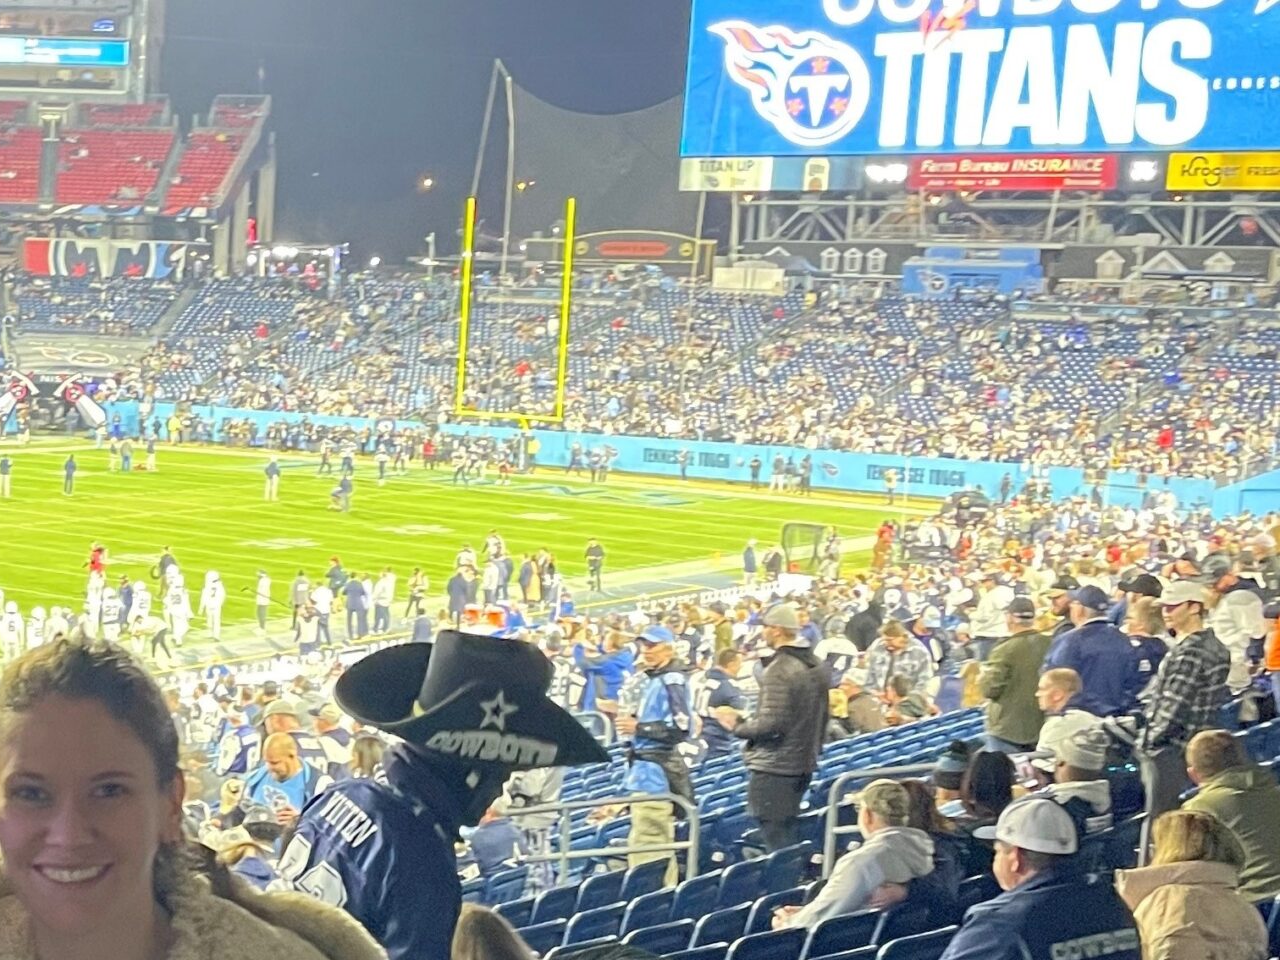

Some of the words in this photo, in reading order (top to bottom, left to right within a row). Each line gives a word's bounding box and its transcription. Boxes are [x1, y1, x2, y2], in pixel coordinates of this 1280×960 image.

[874, 18, 1212, 147] TITANS
[920, 160, 957, 173] Farm
[1011, 158, 1105, 172] INSURANCE
